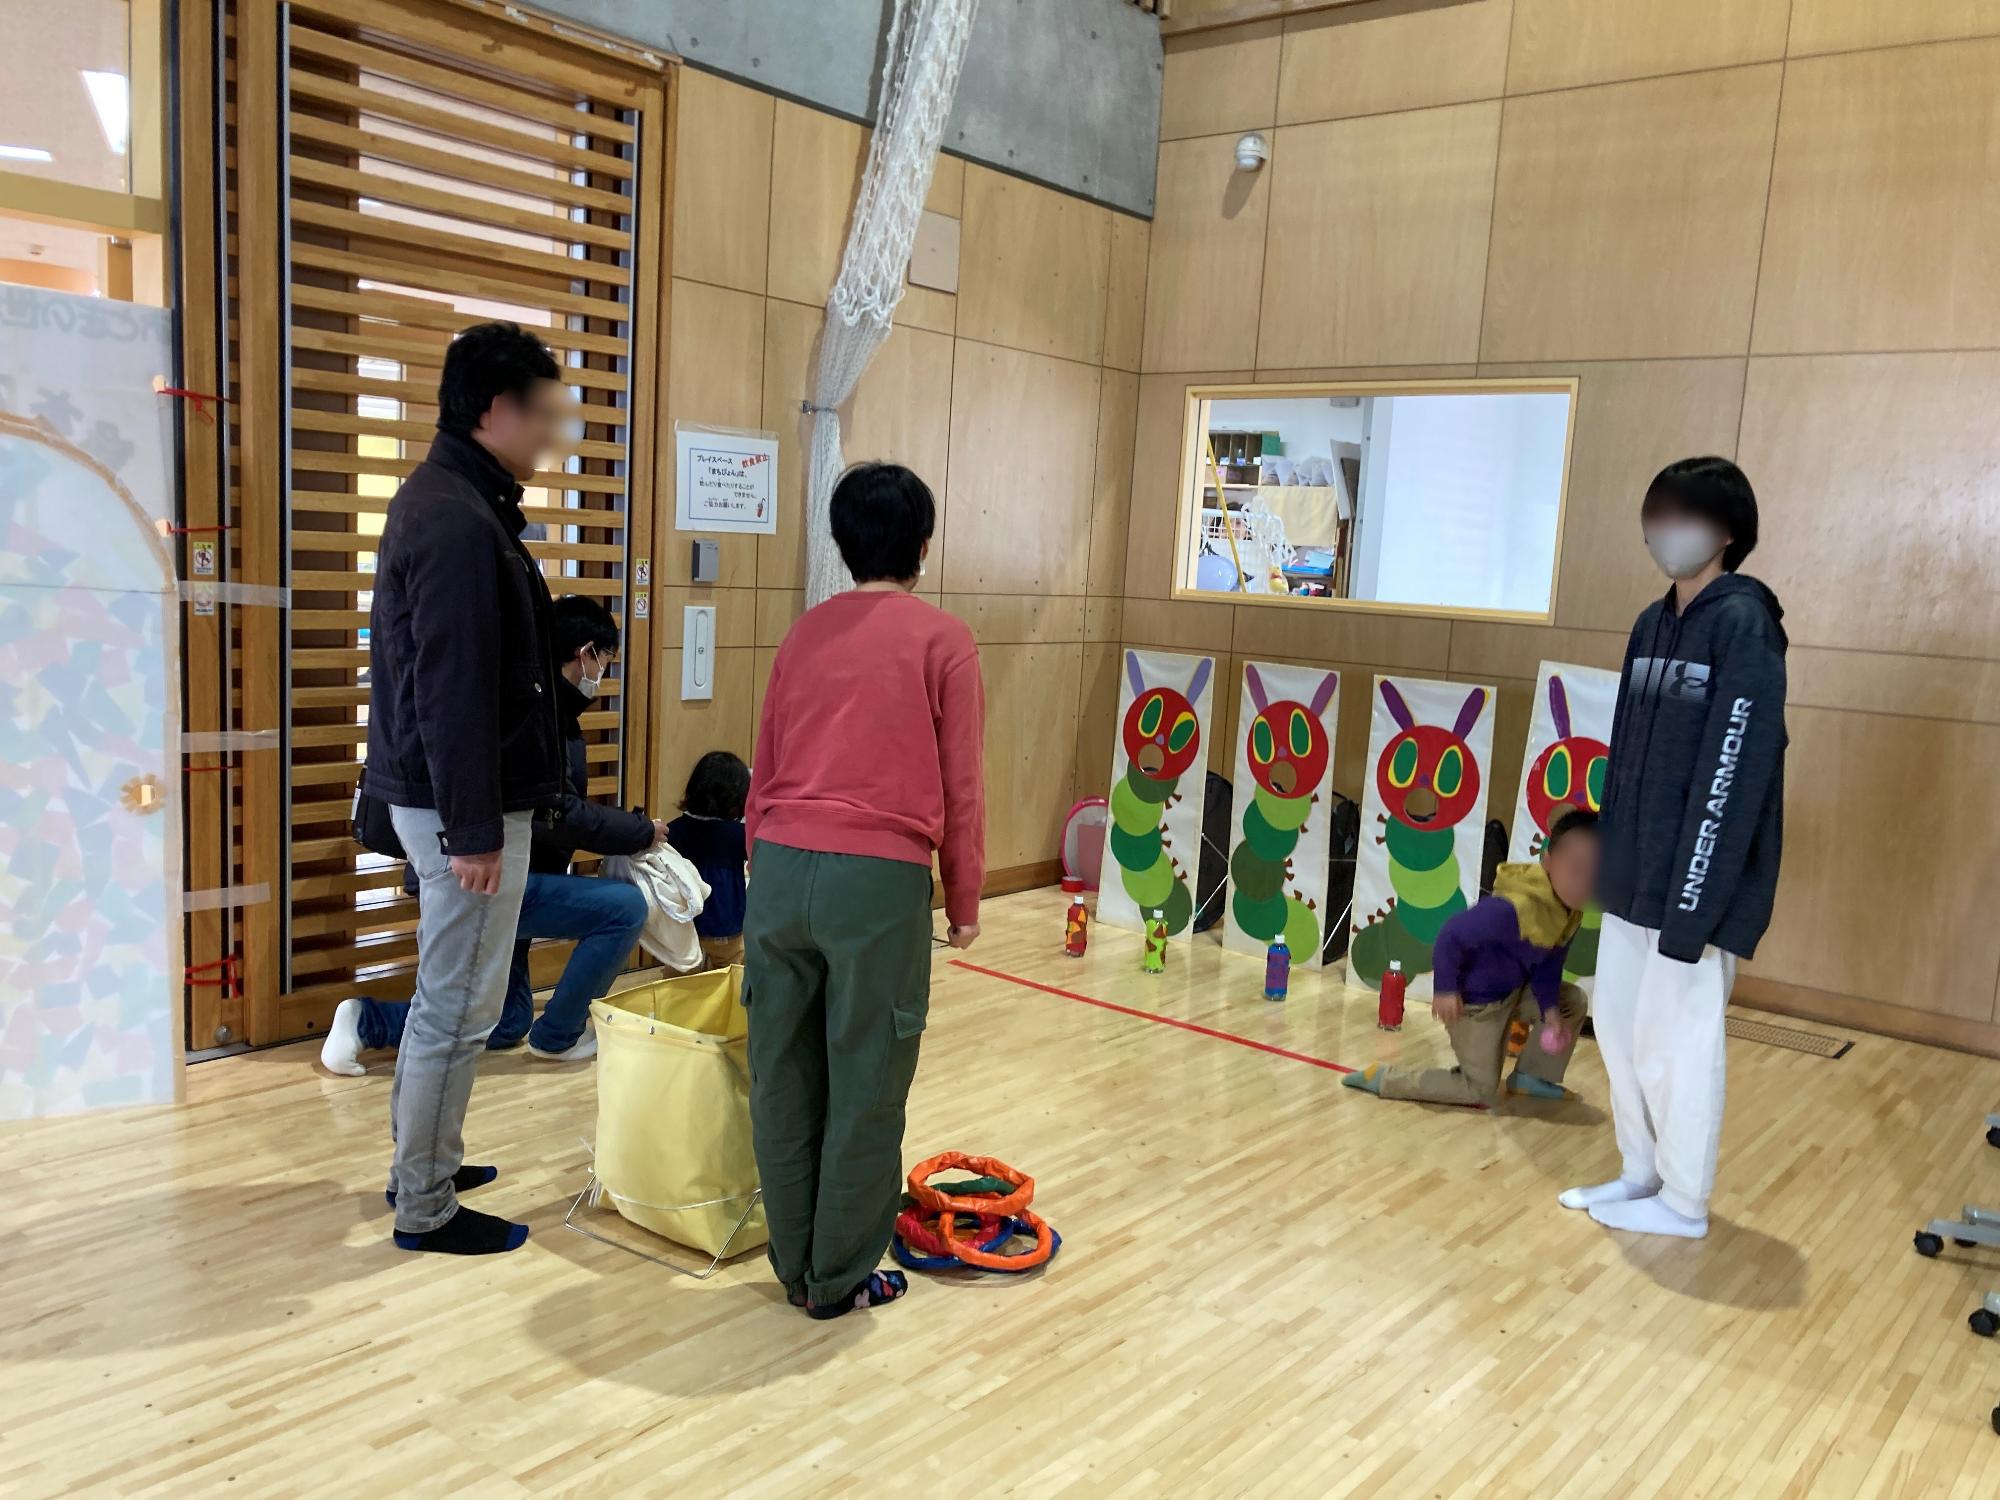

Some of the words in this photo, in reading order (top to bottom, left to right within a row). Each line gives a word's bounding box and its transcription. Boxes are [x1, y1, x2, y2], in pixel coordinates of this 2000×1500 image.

[697, 455, 733, 464] プレイスペース
[700, 480, 754, 490] 飲んだり食べたりすることが
[1677, 819, 1722, 912] UNDER
[1705, 697, 1753, 818] ARMOUR
